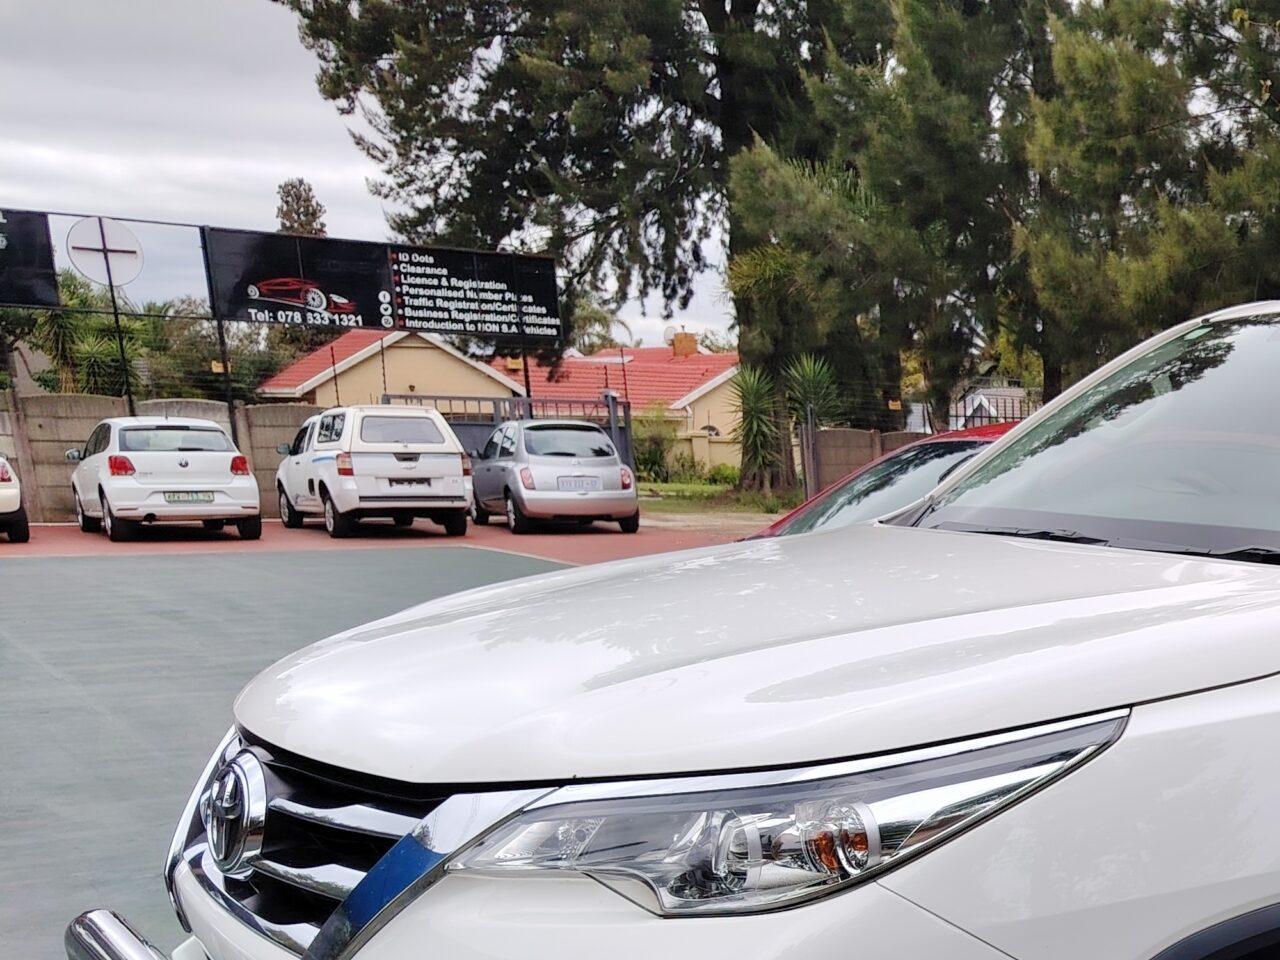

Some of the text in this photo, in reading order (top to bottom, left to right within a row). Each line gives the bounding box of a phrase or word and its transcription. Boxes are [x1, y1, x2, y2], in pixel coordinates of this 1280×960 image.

[398, 252, 410, 262] ID
[400, 263, 448, 275] Clearance
[401, 274, 508, 290] Licence & Registration
[402, 285, 465, 298] Personalised
[504, 291, 534, 303] Ples
[403, 296, 547, 314] Traffic Registraton/Certicates
[248, 308, 274, 322] Tel:
[277, 310, 302, 324] 078
[332, 313, 363, 326] 1321
[404, 307, 450, 319] Business
[406, 318, 464, 330] Introduction
[465, 322, 476, 331] to
